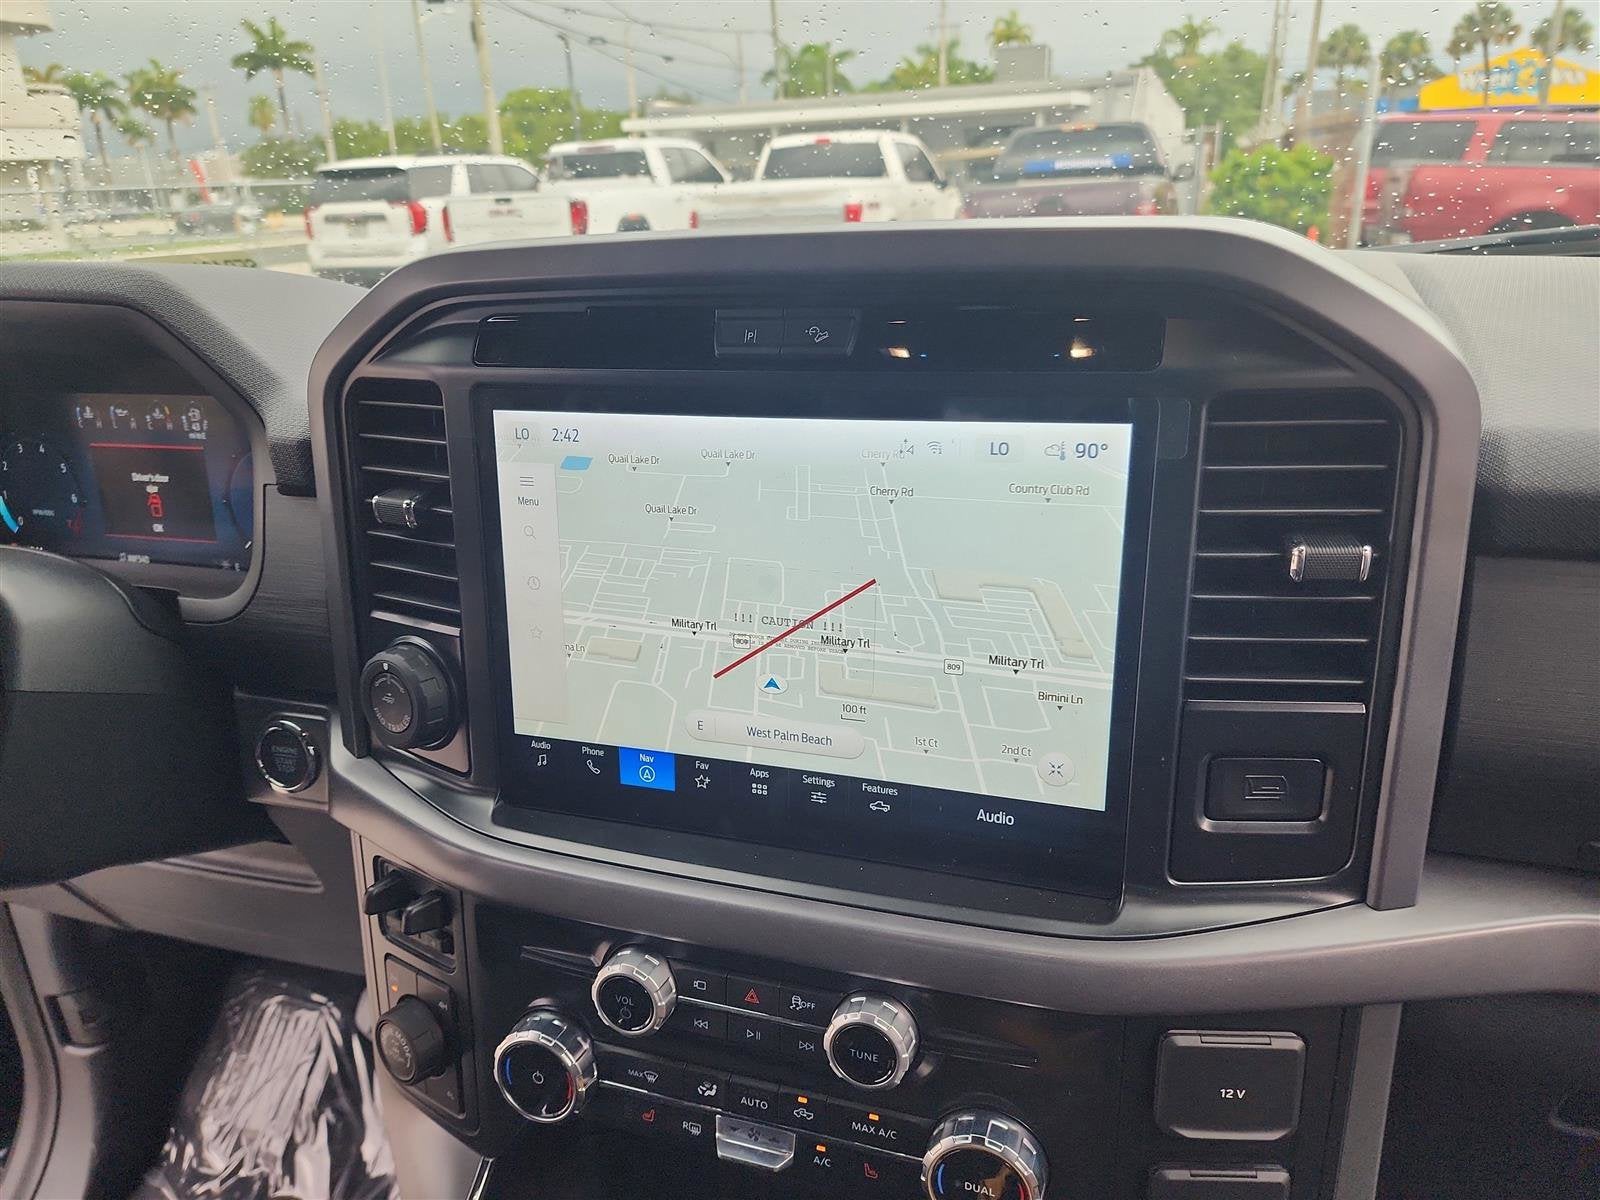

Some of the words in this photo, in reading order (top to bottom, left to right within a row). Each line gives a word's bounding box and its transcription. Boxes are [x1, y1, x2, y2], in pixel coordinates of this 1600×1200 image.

[515, 427, 530, 440] LO
[551, 427, 580, 443] 2:42
[17, 443, 24, 453] 3
[39, 444, 46, 453] 4
[989, 442, 1010, 456] LO
[1075, 442, 1109, 459] 90°
[608, 453, 629, 465] Quail
[630, 455, 649, 464] Lake
[650, 456, 660, 465] Dr
[701, 449, 722, 460] Quail
[724, 450, 745, 459] Lake
[746, 451, 755, 460] Dr
[861, 449, 891, 461] Cherry
[60, 463, 67, 473] 5
[869, 486, 899, 498] Cherry
[901, 487, 914, 497] Rd
[1008, 483, 1048, 496] Country
[1050, 484, 1073, 495] Club
[1075, 485, 1089, 496] Rd
[71, 493, 78, 503] 6
[517, 496, 540, 506] Menu
[645, 504, 666, 515] Quail
[667, 505, 687, 515] Lake
[688, 506, 697, 515] Dr
[671, 618, 703, 631] Military
[705, 620, 717, 631] Trl
[761, 616, 814, 629] CAUTION
[820, 635, 855, 648] Military
[857, 637, 870, 648] Trl
[946, 662, 961, 672] 809
[988, 655, 1028, 669] Military
[1029, 658, 1044, 669] Trl
[1038, 691, 1069, 703] Bimini
[1071, 694, 1083, 704] Ln
[841, 704, 858, 714] 100
[859, 705, 867, 715] ft
[697, 720, 703, 731] E
[746, 726, 772, 738] West
[774, 729, 799, 742] Palm
[801, 732, 833, 746] Beach
[531, 740, 551, 750] Audio
[914, 737, 927, 747] 1st
[928, 738, 938, 748] Ct
[582, 746, 604, 757] Phone
[1001, 745, 1019, 756] 2nd
[1020, 747, 1032, 757] Ct
[639, 753, 655, 763] Nav
[695, 760, 709, 771] Fav
[750, 768, 770, 779] Apps
[802, 775, 835, 788] Settings
[862, 783, 898, 796] Features
[976, 809, 1015, 826] Audio
[615, 994, 634, 1006] VOL
[800, 1000, 816, 1010] OFF
[850, 1049, 879, 1063] TUNE
[628, 1068, 643, 1078] MAX
[1220, 1088, 1234, 1099] 12
[1236, 1089, 1246, 1099] V
[740, 1097, 768, 1110] AUTO
[851, 1121, 876, 1135] MAX
[878, 1127, 897, 1140] A/C
[813, 1155, 831, 1168] A/C
[964, 1181, 995, 1197] DUAL
